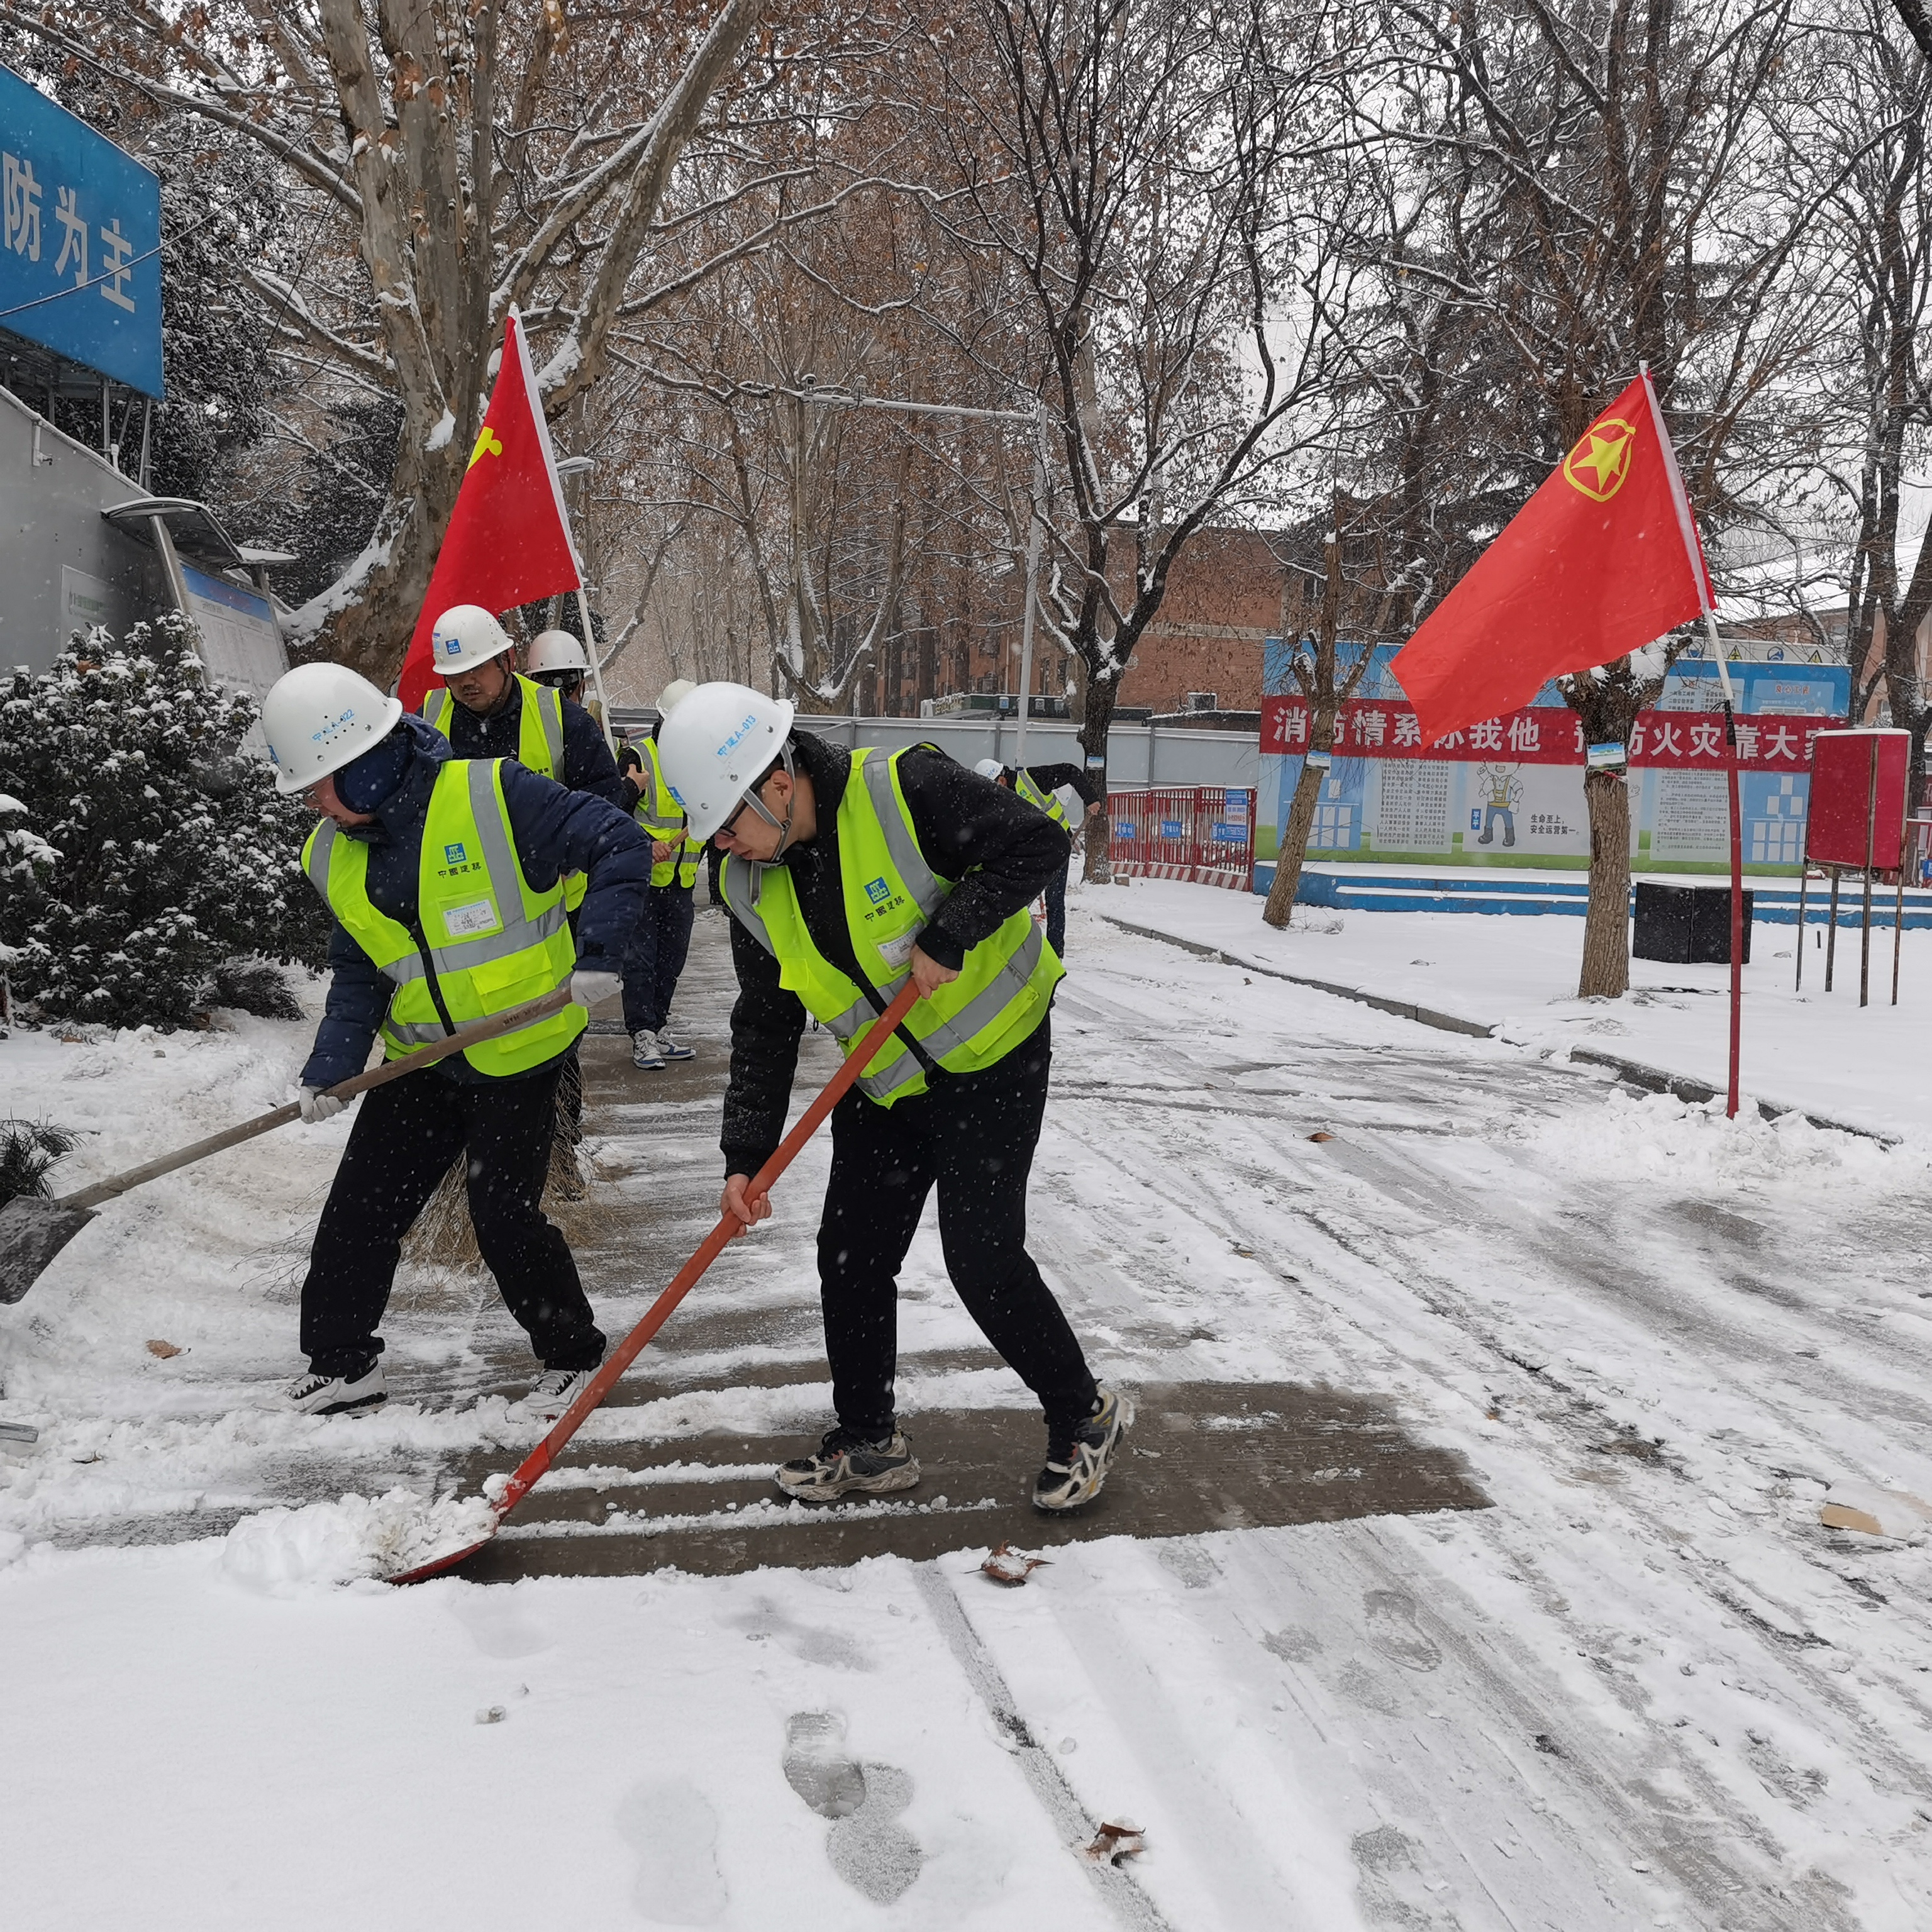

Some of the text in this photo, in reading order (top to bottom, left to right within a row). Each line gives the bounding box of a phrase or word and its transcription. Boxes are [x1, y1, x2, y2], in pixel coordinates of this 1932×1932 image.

[3, 151, 135, 313] 防为主
[717, 714, 756, 756] 中建A-013
